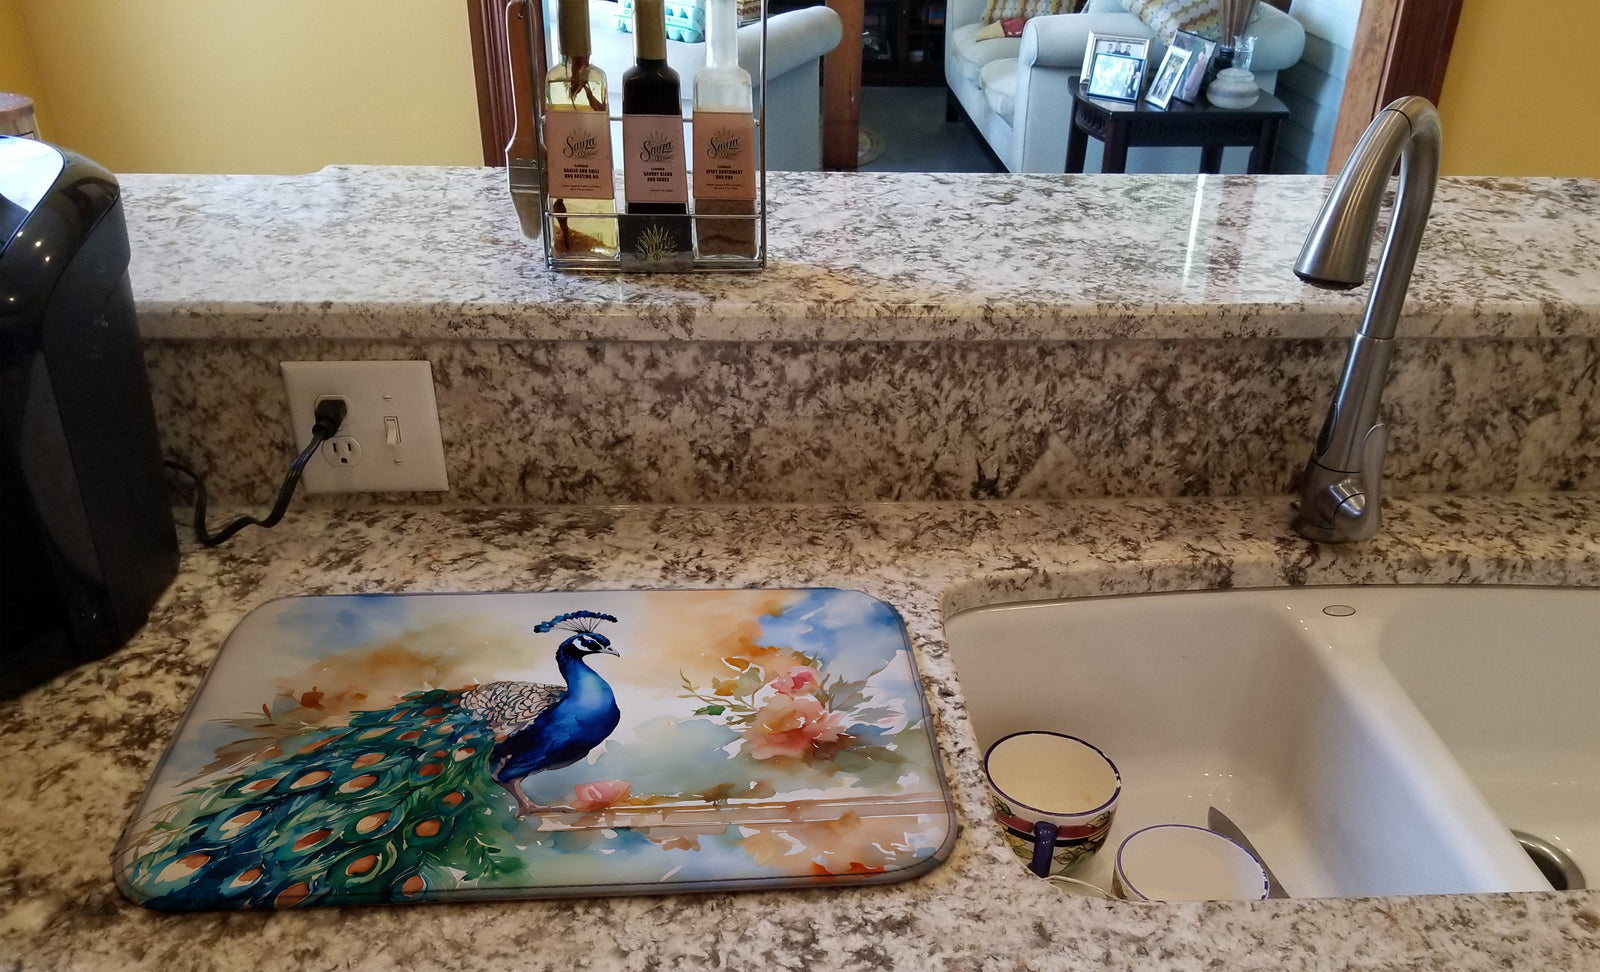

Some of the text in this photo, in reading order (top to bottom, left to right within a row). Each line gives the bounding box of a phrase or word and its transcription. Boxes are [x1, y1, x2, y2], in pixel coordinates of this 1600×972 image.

[563, 136, 597, 158] Sauza
[640, 140, 674, 162] Sauza
[707, 137, 740, 159] Sauza
